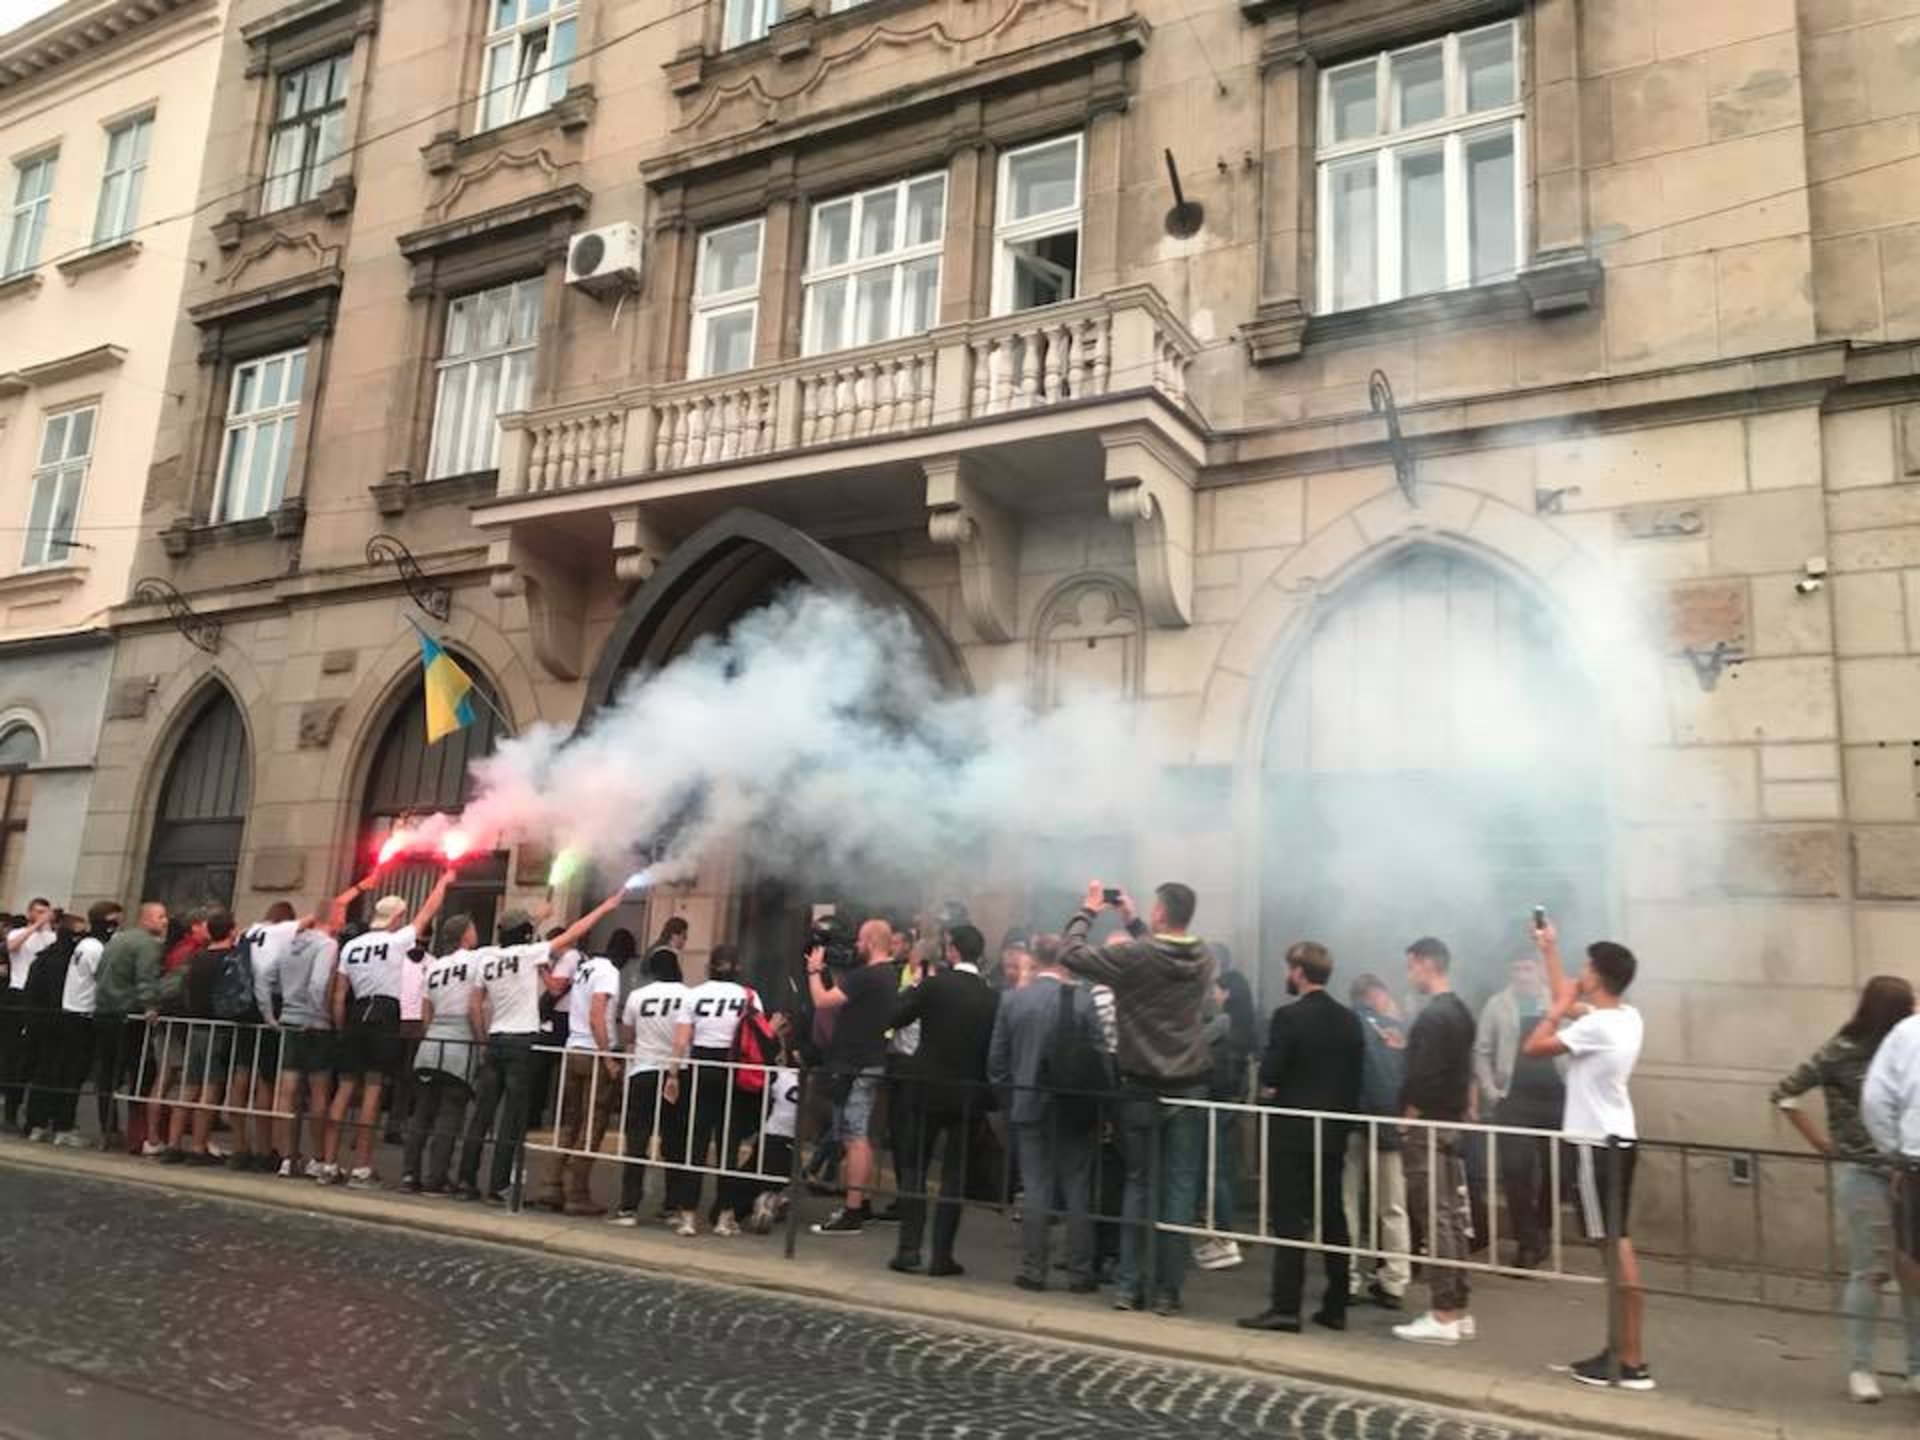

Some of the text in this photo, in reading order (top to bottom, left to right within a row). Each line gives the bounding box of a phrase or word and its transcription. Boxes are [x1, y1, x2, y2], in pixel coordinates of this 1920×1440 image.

[347, 943, 390, 965] C14
[428, 963, 468, 989] C14
[483, 955, 520, 982] C14
[695, 998, 746, 1018] C14
